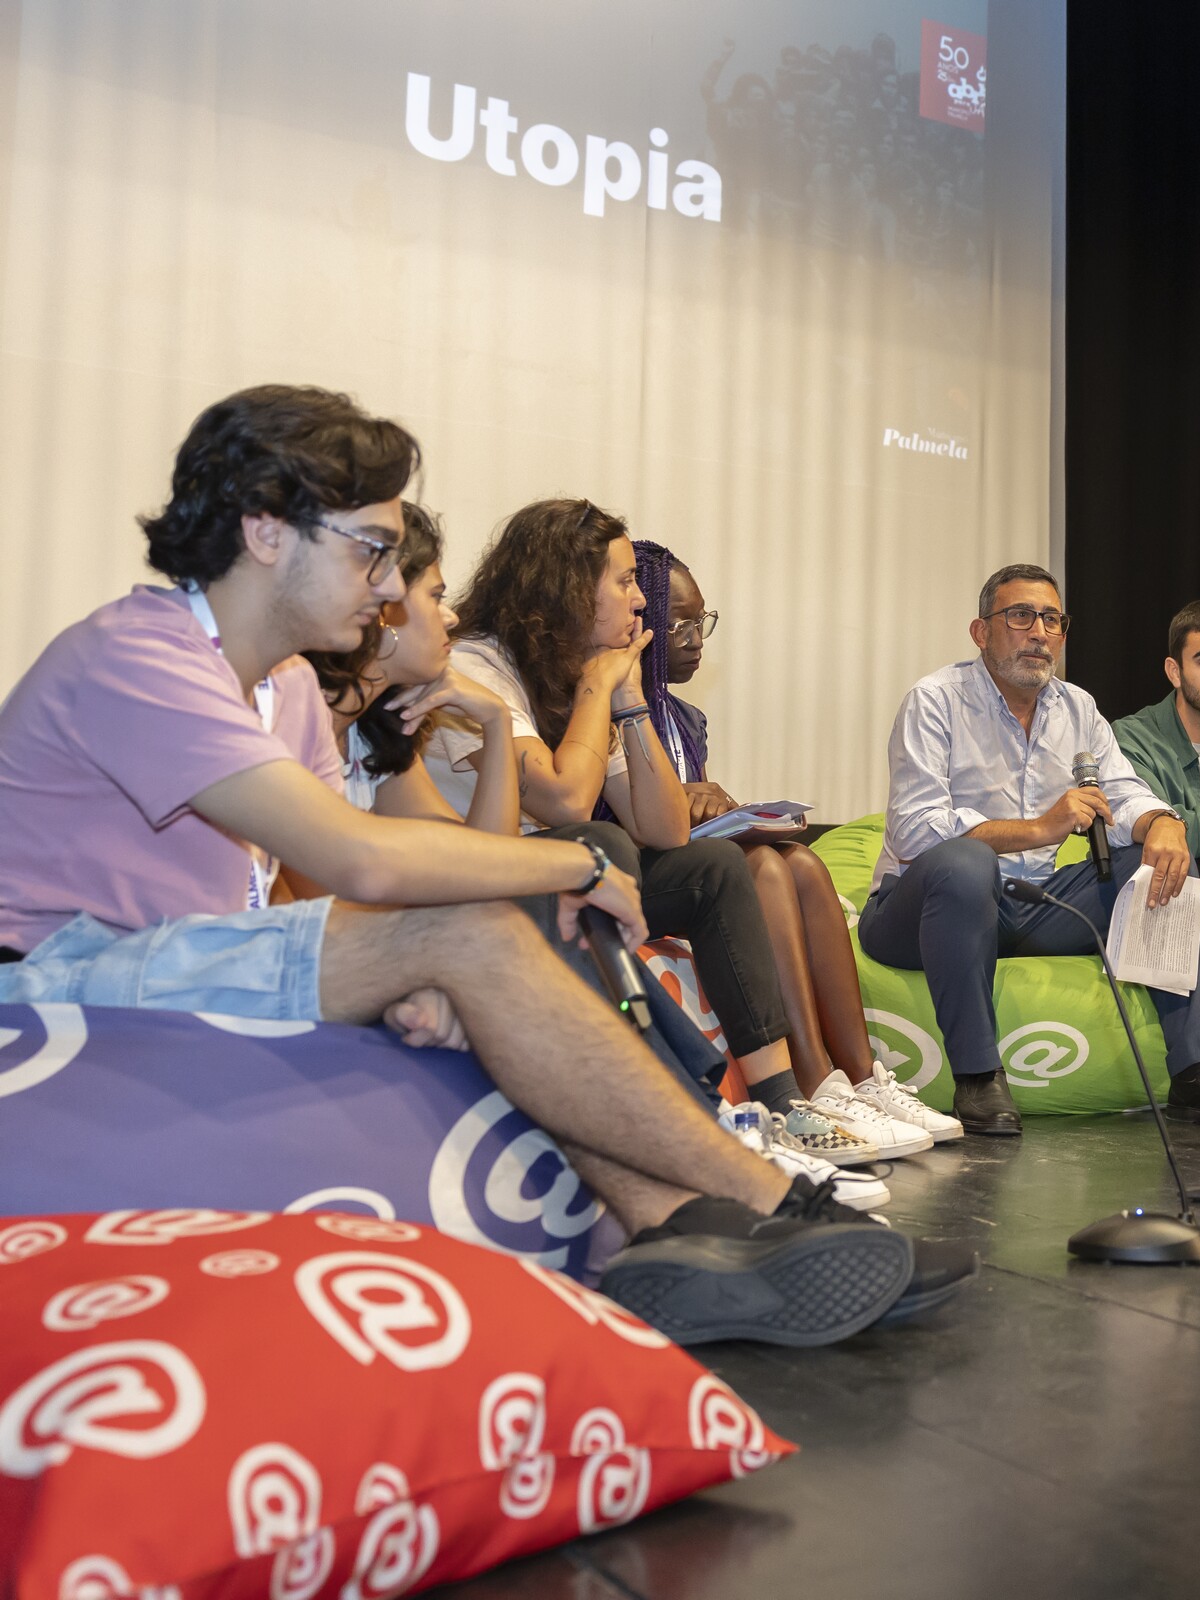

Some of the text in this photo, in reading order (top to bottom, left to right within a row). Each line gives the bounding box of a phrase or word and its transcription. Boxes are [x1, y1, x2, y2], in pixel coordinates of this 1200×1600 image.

[938, 35, 969, 69] 50
[405, 71, 722, 222] Utopia
[882, 427, 968, 460] Palmela
